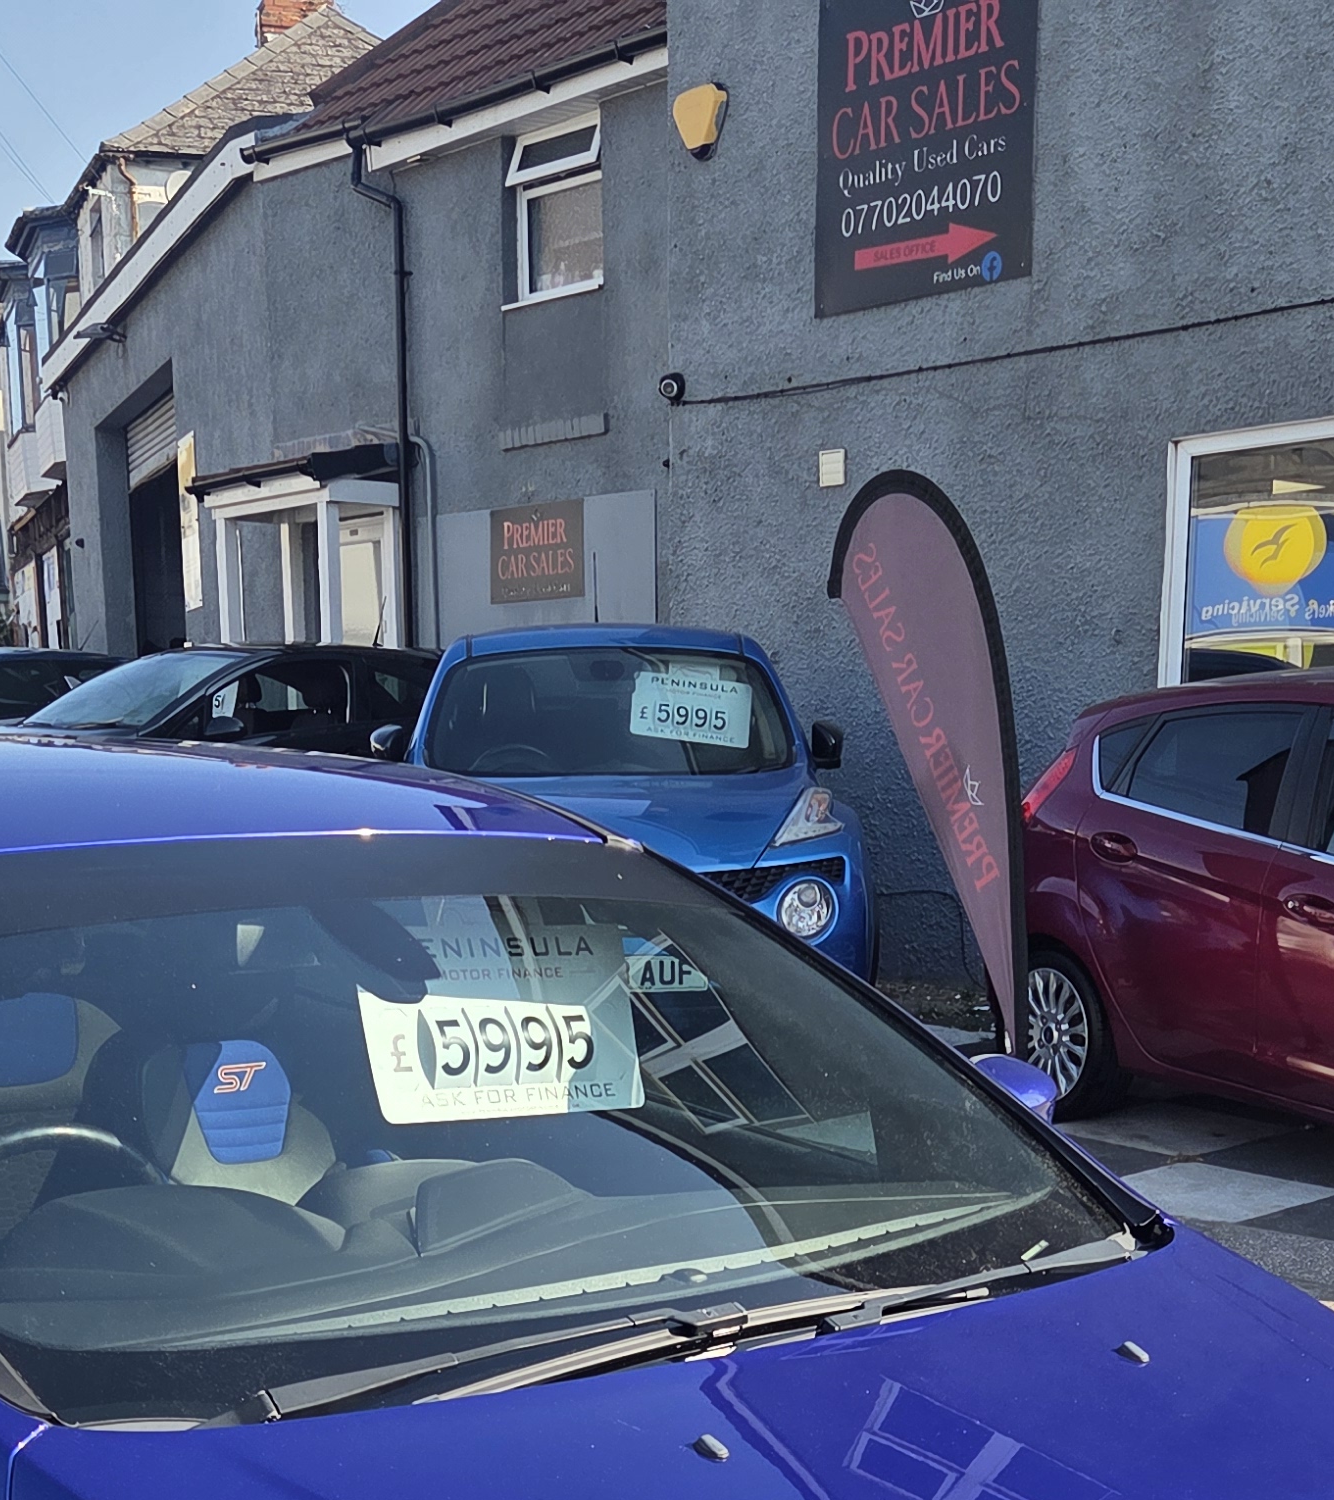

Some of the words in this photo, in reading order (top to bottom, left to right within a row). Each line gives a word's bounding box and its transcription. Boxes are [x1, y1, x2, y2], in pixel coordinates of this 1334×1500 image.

[845, 0, 1005, 92] PREMIER
[832, 95, 901, 160] CAR
[909, 60, 1021, 139] SALES
[839, 159, 906, 197] Quality
[913, 139, 957, 173] Used
[964, 134, 1007, 161] Cars
[841, 171, 1002, 237] 07702044070
[873, 243, 901, 262] SALES
[933, 267, 952, 284] Find
[954, 266, 966, 279] Us
[967, 263, 981, 276] On
[503, 518, 567, 549] PREMIER
[498, 554, 528, 580] CAR
[530, 548, 575, 577] SALES
[651, 676, 739, 694] PENINSULA
[657, 703, 727, 731] 5995
[669, 729, 690, 737] FOR
[692, 732, 736, 744] FINANCE
[421, 935, 594, 959] ENINSULA
[498, 965, 564, 979] FINANCE
[390, 1034, 413, 1073] £
[435, 1014, 595, 1077] 5995
[213, 1062, 267, 1094] ST
[474, 1087, 517, 1105] FOR
[525, 1082, 616, 1102] FINANCE
